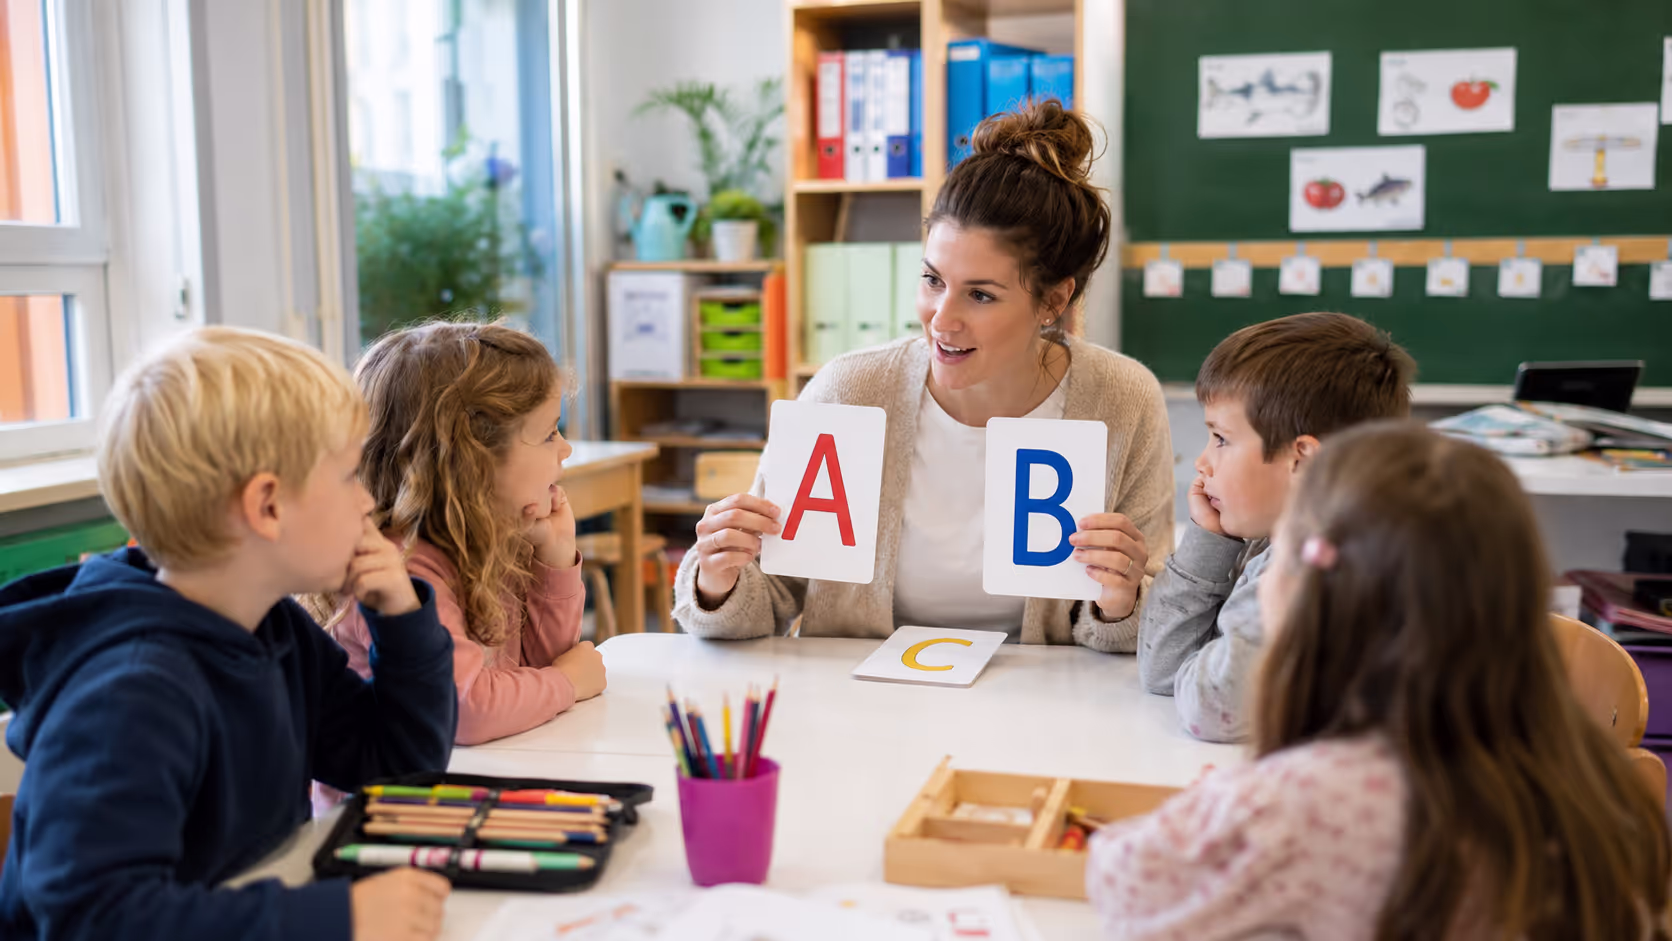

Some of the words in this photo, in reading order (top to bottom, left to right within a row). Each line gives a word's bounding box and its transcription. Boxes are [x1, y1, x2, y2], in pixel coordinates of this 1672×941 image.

[781, 433, 856, 547] A
[1012, 448, 1077, 567] B
[901, 637, 973, 672] C
